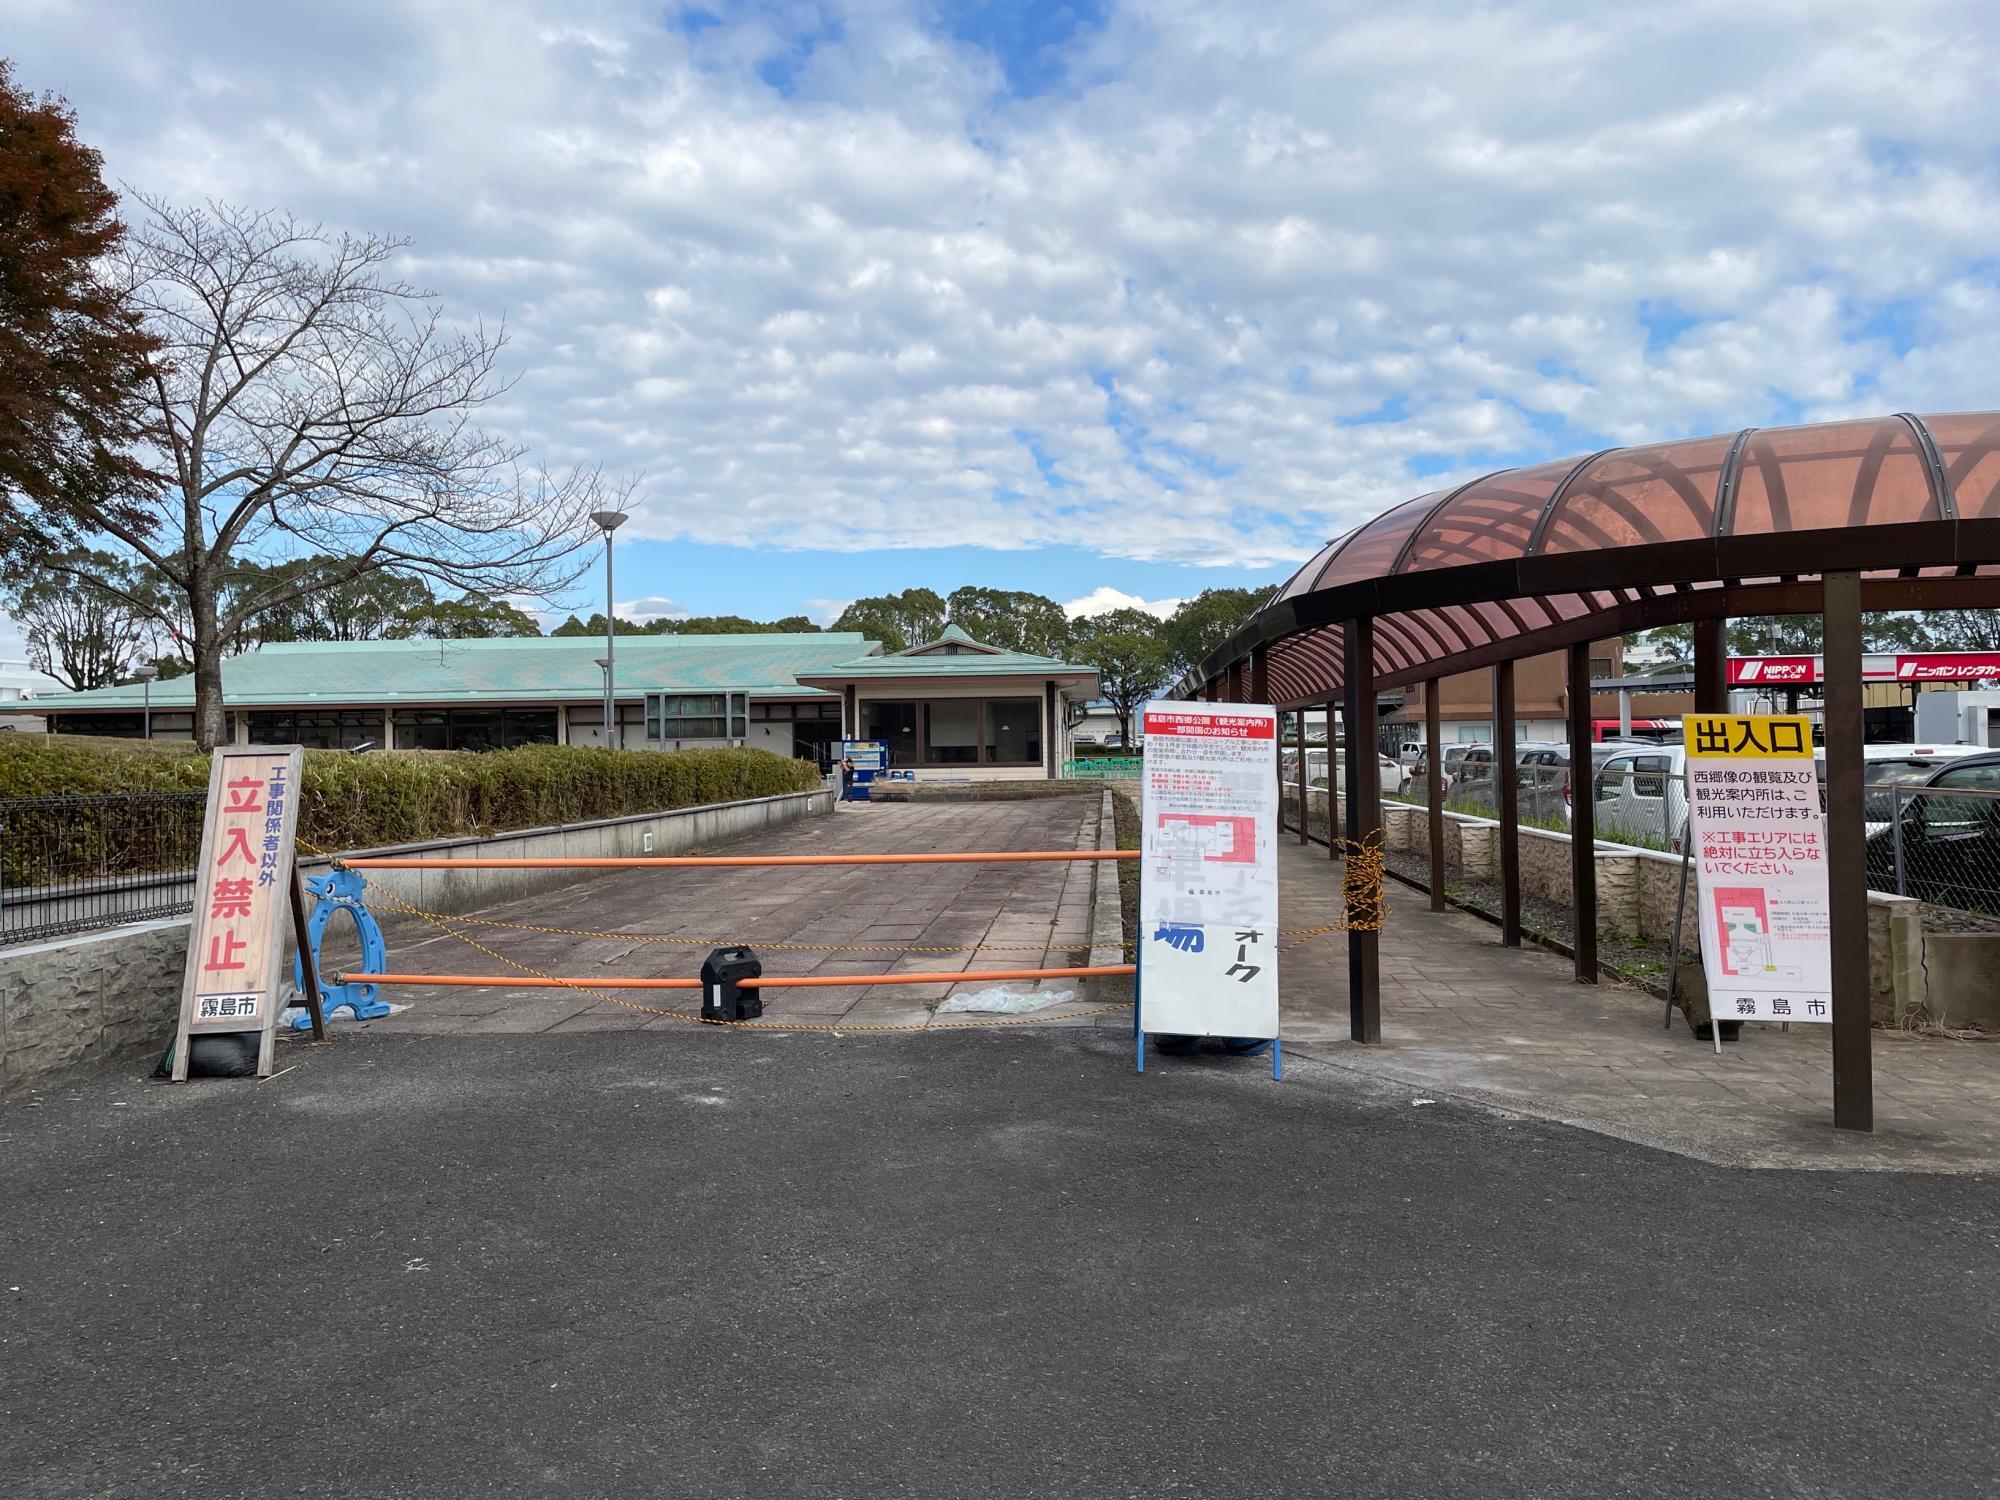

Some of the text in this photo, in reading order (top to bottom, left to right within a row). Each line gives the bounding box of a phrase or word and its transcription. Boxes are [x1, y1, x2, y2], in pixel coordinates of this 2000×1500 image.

[1763, 665, 1807, 674] NIPPON
[1696, 720, 1804, 753] 出入口
[1694, 771, 1812, 784] 西郷像の観覧及び
[1696, 788, 1807, 801] 観光案内所は、ご
[1697, 806, 1819, 820] 利用いただけます。
[258, 766, 287, 888] 工事関係者以外
[1703, 831, 1818, 844] ※工事エリアには
[1703, 846, 1820, 860] 絶対に立ち入らな
[204, 775, 265, 971] 立入禁止
[1705, 862, 1794, 876] いでください。
[200, 997, 257, 1017] 霧島市
[1736, 997, 1826, 1016] 霧島市
